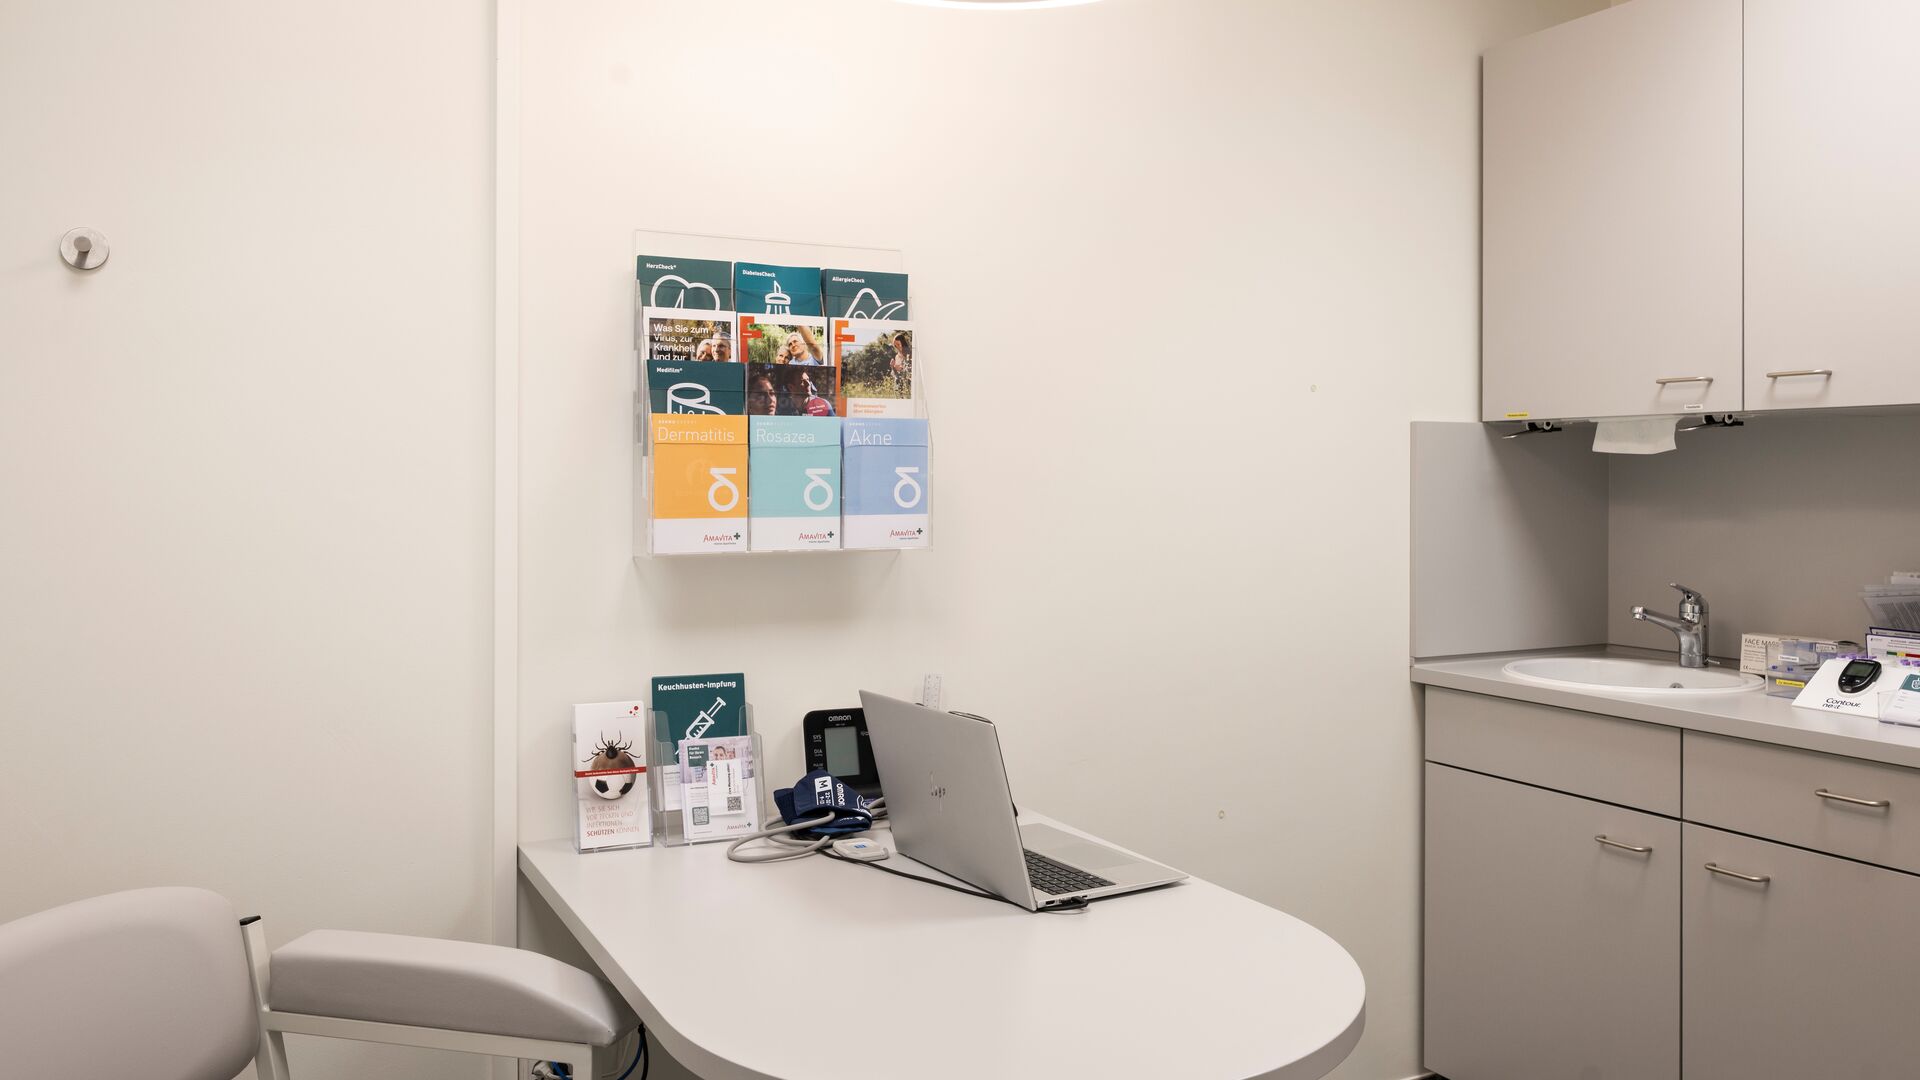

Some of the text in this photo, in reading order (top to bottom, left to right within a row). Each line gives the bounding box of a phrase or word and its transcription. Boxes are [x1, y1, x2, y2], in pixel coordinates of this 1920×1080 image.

[653, 323, 673, 333] Was
[674, 324, 689, 333] Sie
[653, 333, 678, 343] Virus,
[653, 343, 696, 353] Krankheit
[653, 353, 671, 361] und
[657, 426, 735, 442] Dermatitis
[756, 428, 816, 444] Rosazea
[849, 429, 893, 446] Akne
[658, 681, 736, 692] Keuchhusten-Impfung
[819, 780, 829, 789] M
